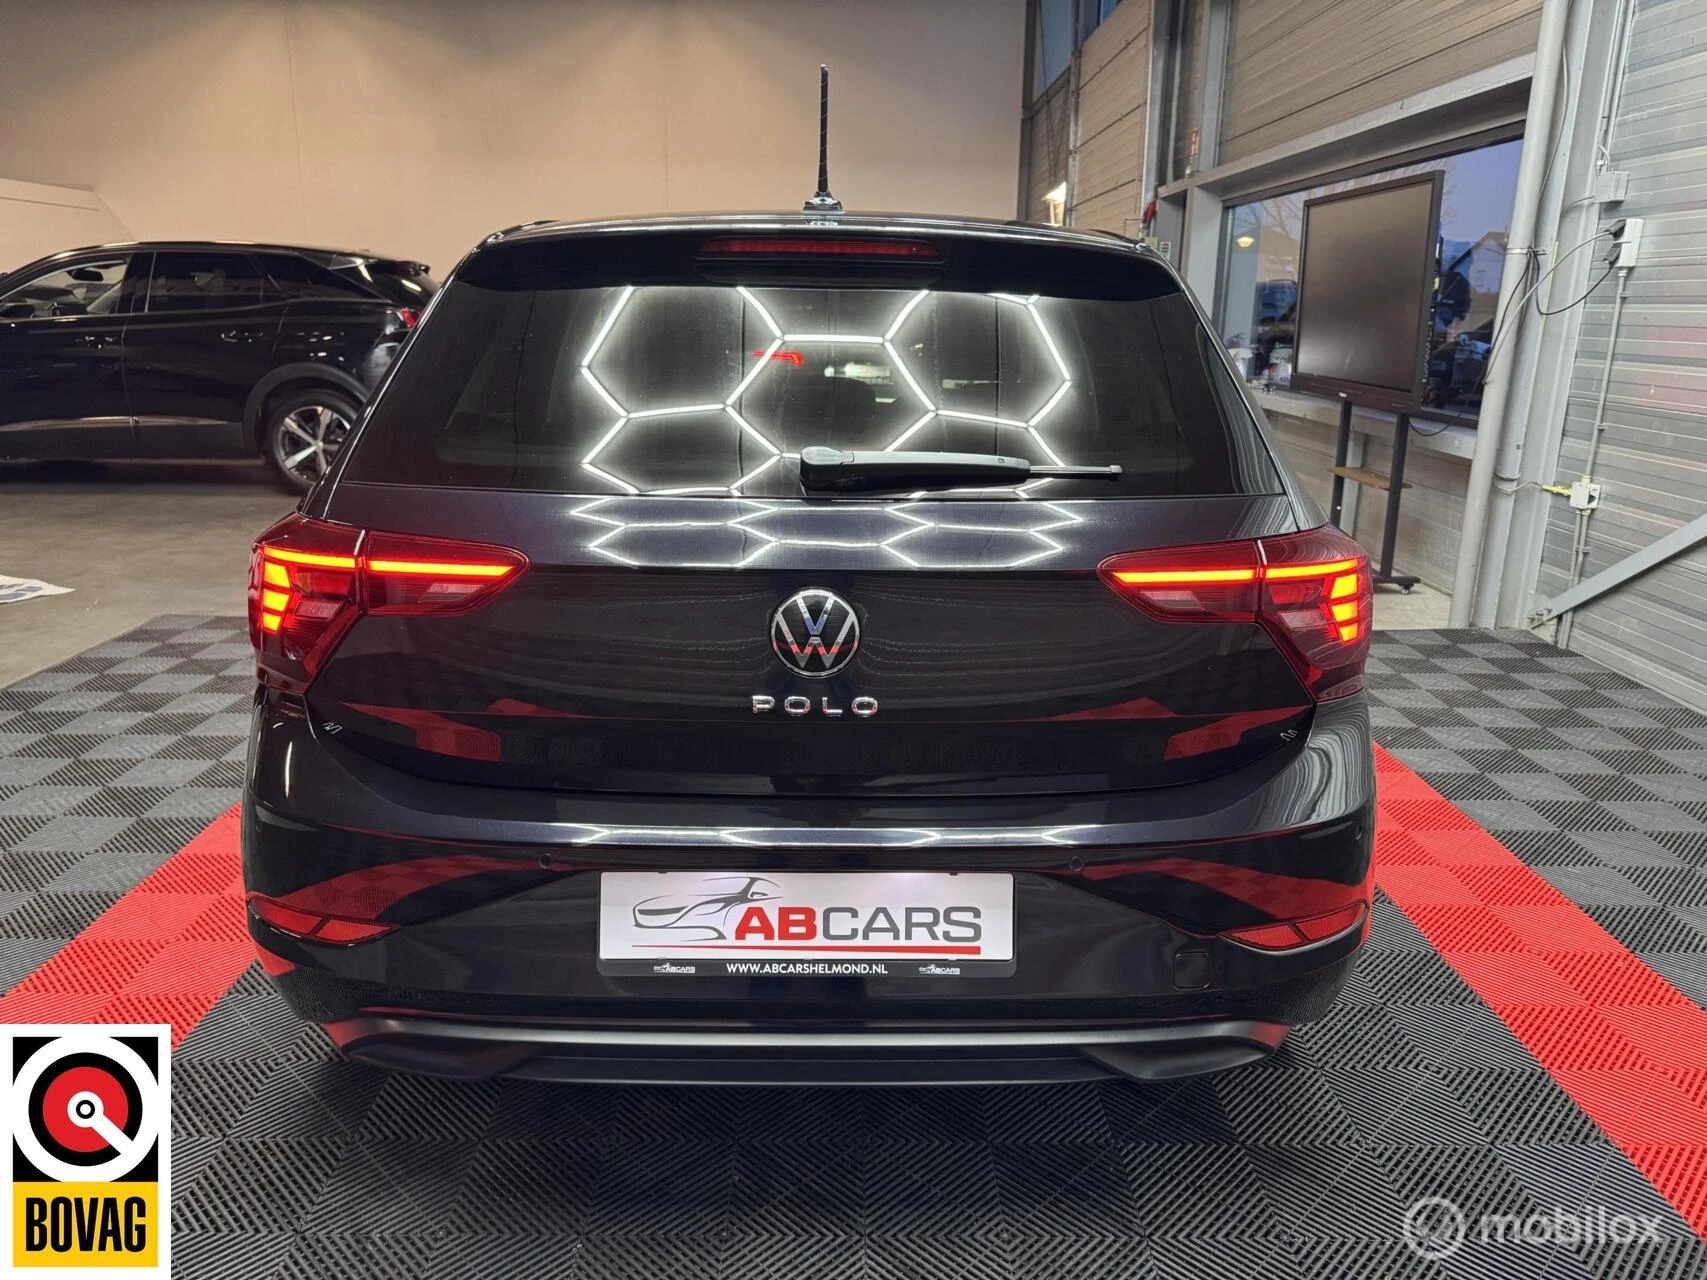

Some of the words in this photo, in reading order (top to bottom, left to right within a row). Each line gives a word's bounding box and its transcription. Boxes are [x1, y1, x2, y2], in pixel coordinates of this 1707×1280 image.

[752, 695, 879, 717] POLO
[734, 906, 982, 943] ABCARS
[726, 963, 888, 975] WWW.ABCARSHELMOND.NL
